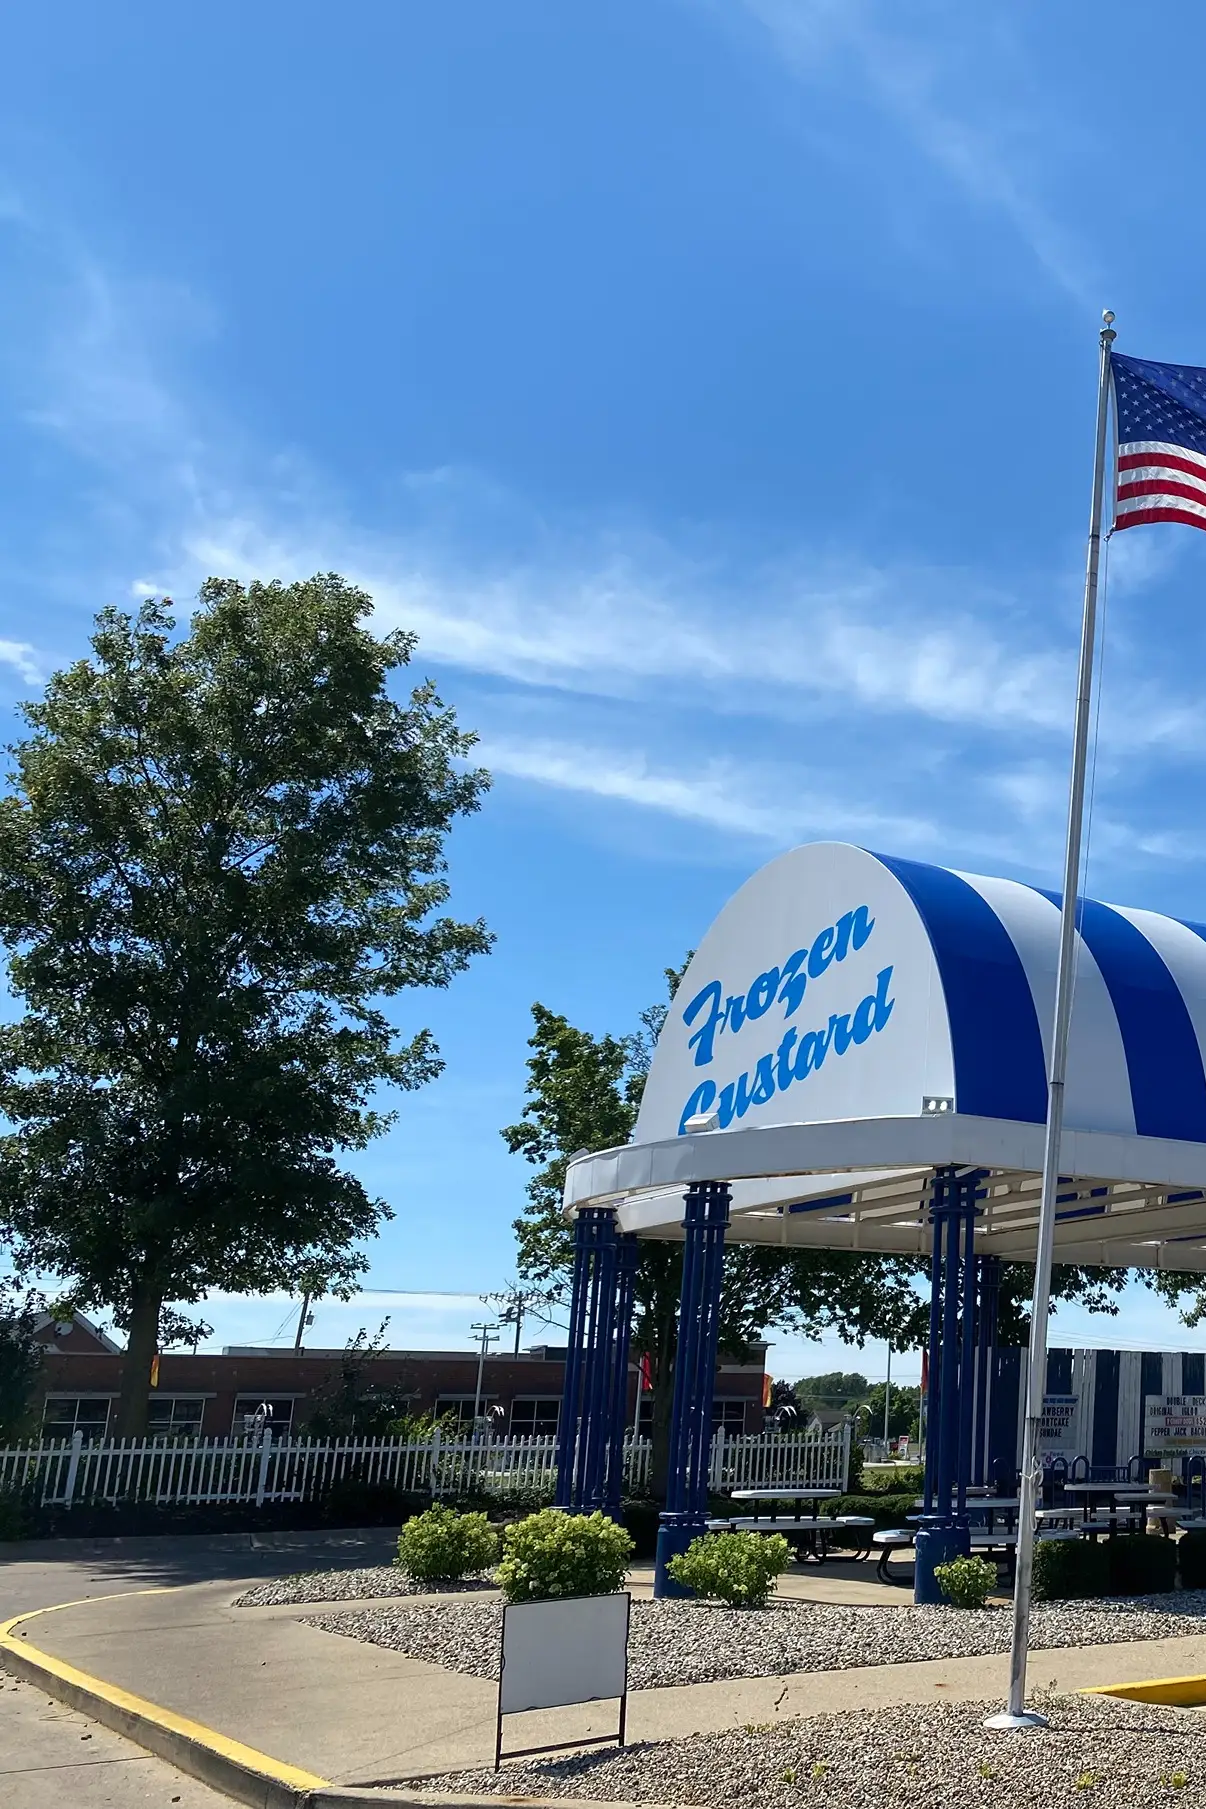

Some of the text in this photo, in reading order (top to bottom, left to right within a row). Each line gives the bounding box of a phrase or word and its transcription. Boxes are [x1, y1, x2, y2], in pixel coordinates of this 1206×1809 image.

[682, 905, 876, 1067] Frozen
[678, 965, 895, 1136] Custard
[1166, 1397, 1186, 1406] DOUBLE
[1041, 1406, 1074, 1416] AWBERRY
[1150, 1406, 1173, 1416] ORIGINAL
[1041, 1417, 1069, 1427] ORTCAKE
[1150, 1427, 1171, 1437] PEPPER
[1173, 1427, 1187, 1437] JACK
